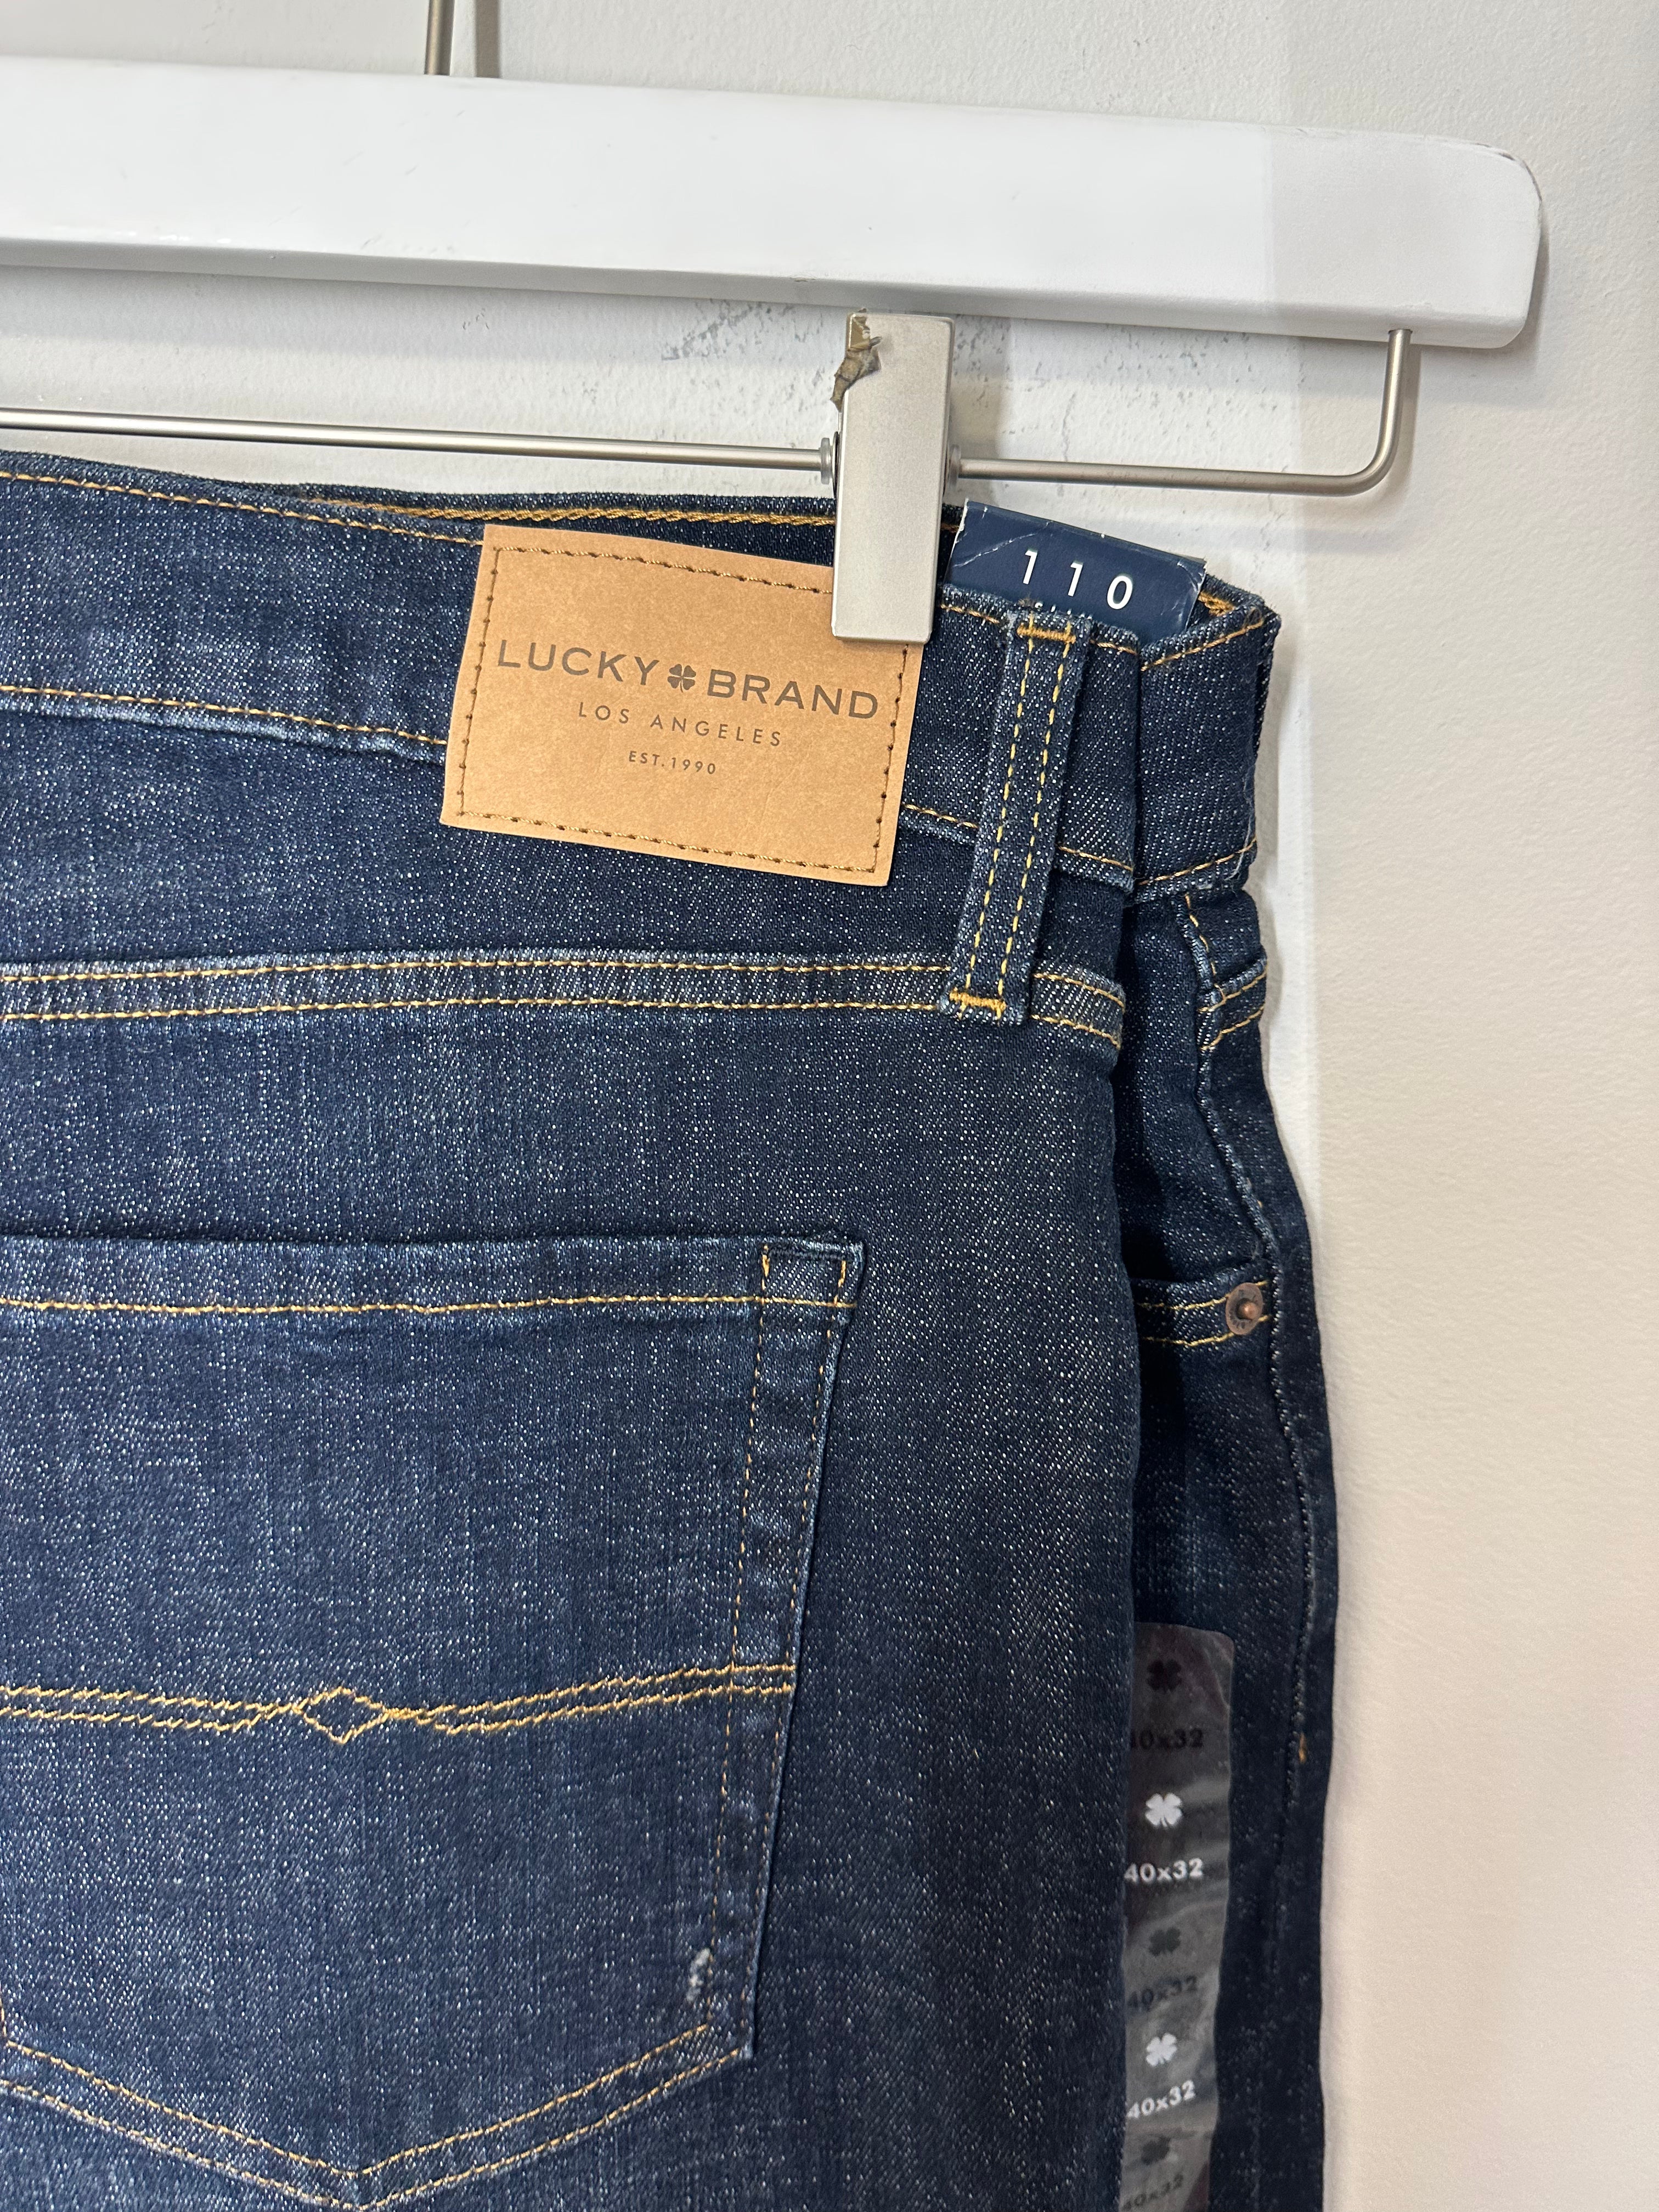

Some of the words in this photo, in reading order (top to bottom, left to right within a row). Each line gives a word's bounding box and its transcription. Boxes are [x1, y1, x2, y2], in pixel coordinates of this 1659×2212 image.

[1023, 549, 1133, 610] 110
[497, 639, 659, 686] LUCKY
[707, 669, 878, 719] BRAND
[578, 702, 629, 724] LOS
[650, 714, 782, 747] ANGELES
[628, 751, 716, 775] EST.1990
[1125, 1858, 1204, 1883] 40x32
[1126, 2080, 1197, 2119] 40x32
